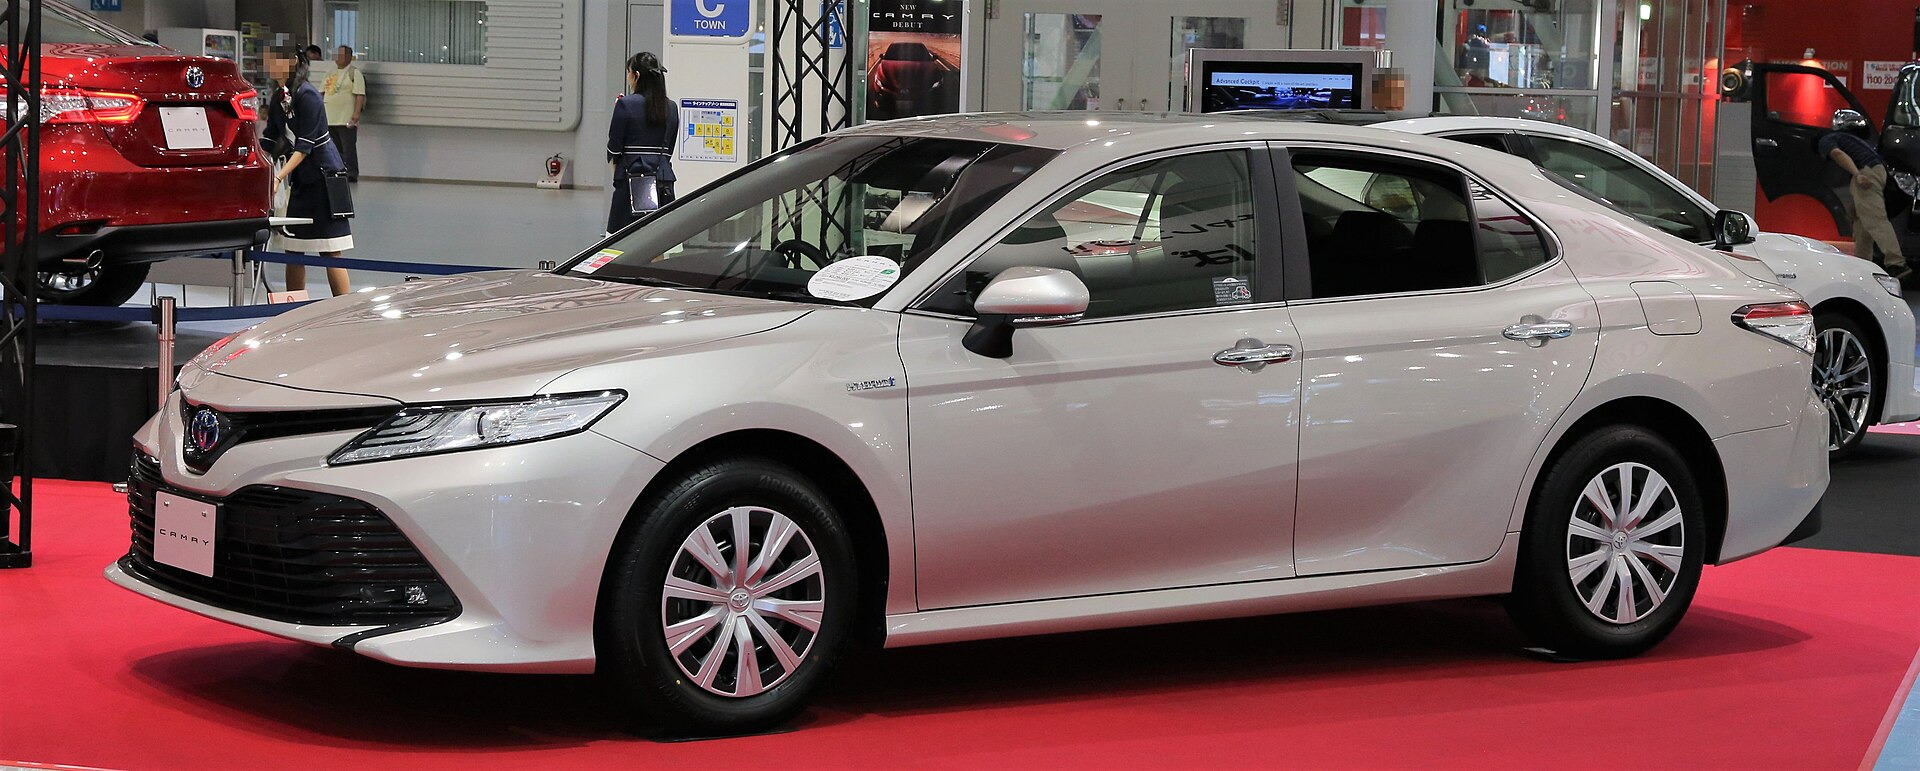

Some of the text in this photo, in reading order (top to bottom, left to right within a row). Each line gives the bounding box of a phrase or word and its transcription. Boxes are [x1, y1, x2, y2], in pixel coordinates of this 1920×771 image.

[873, 12, 954, 20] CAMRY
[693, 19, 726, 30] TOWN
[892, 21, 924, 29] DEBUT
[159, 528, 209, 546] CAMRY
